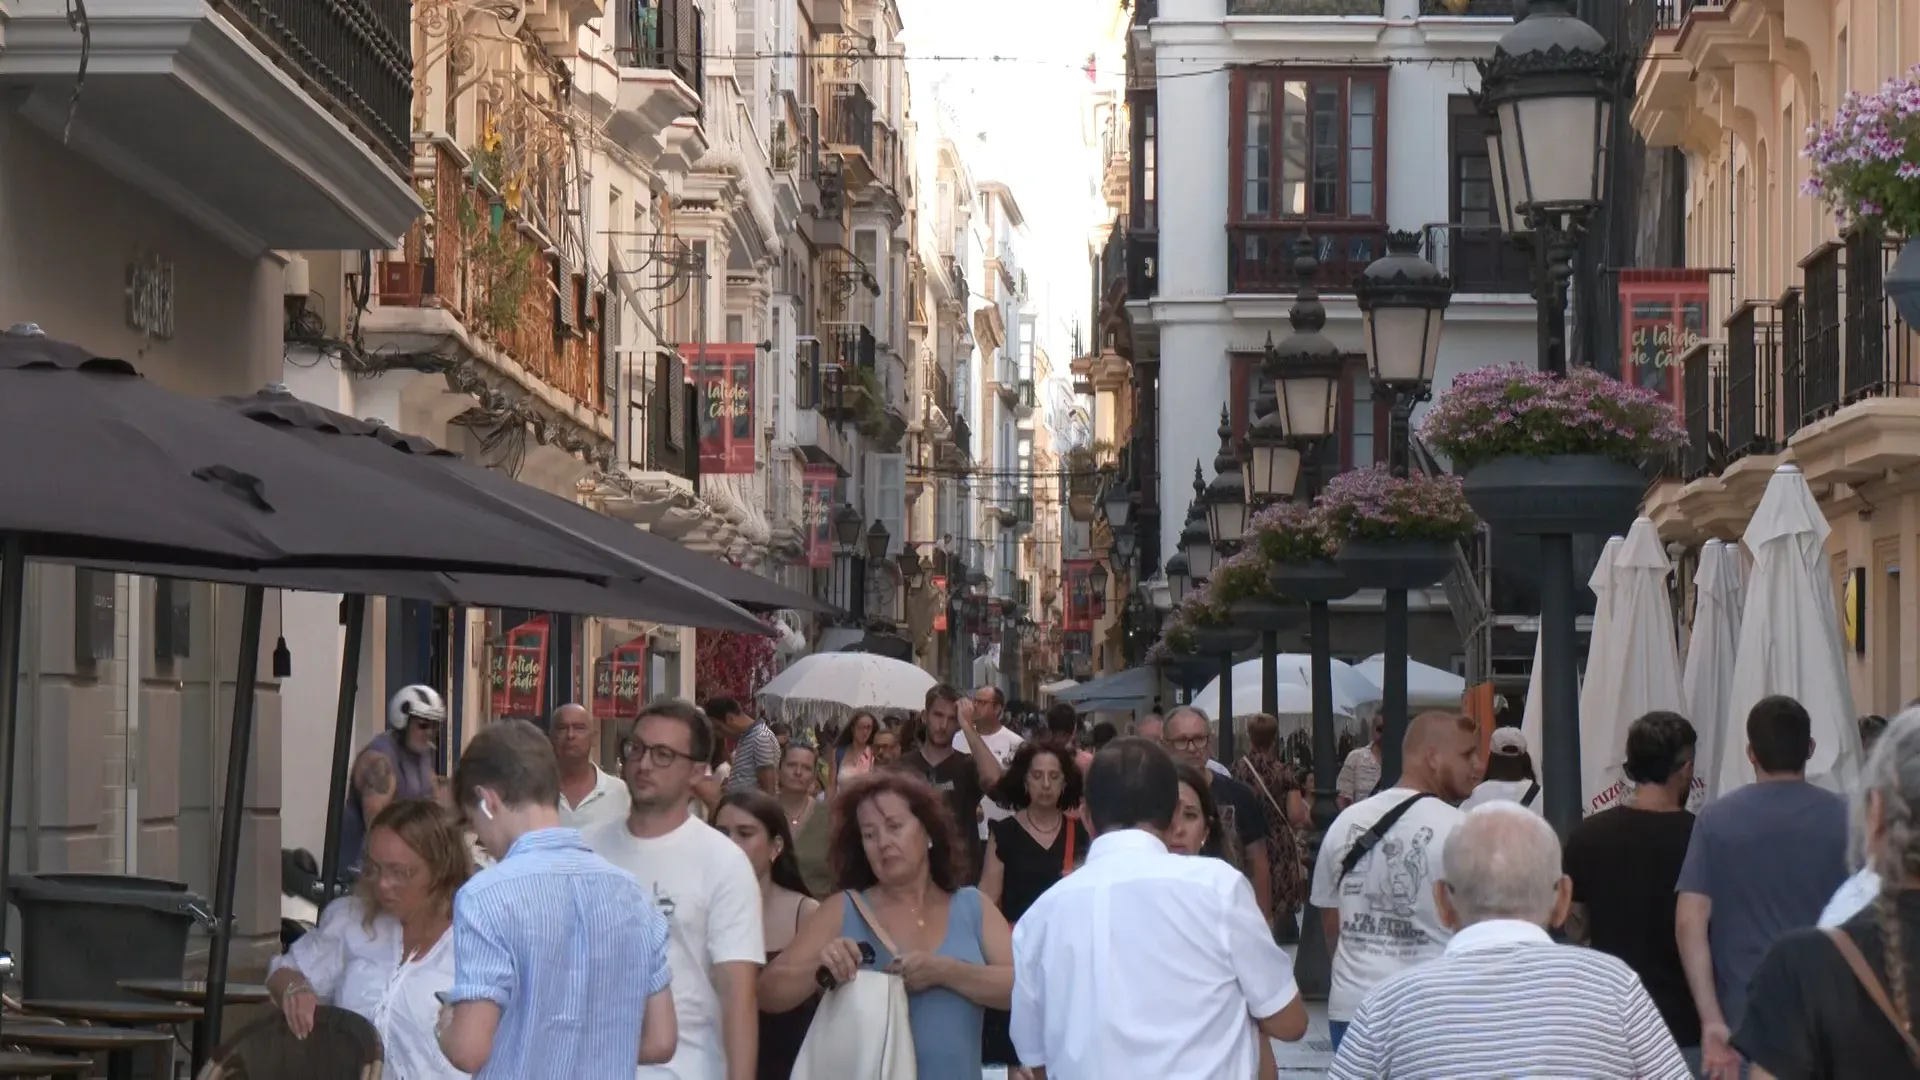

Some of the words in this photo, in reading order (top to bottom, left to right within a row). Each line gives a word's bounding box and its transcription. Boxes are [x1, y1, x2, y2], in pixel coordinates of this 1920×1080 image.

[1631, 327, 1648, 346] el
[1652, 321, 1699, 347] latido
[1628, 347, 1650, 366] de
[707, 378, 748, 400] latido
[709, 401, 749, 418] Cádiz
[507, 654, 541, 674] latido
[507, 671, 541, 689] Cádiz
[599, 670, 610, 683] el
[612, 668, 641, 685] latido
[597, 683, 610, 696] de
[612, 684, 641, 698] Cádiz
